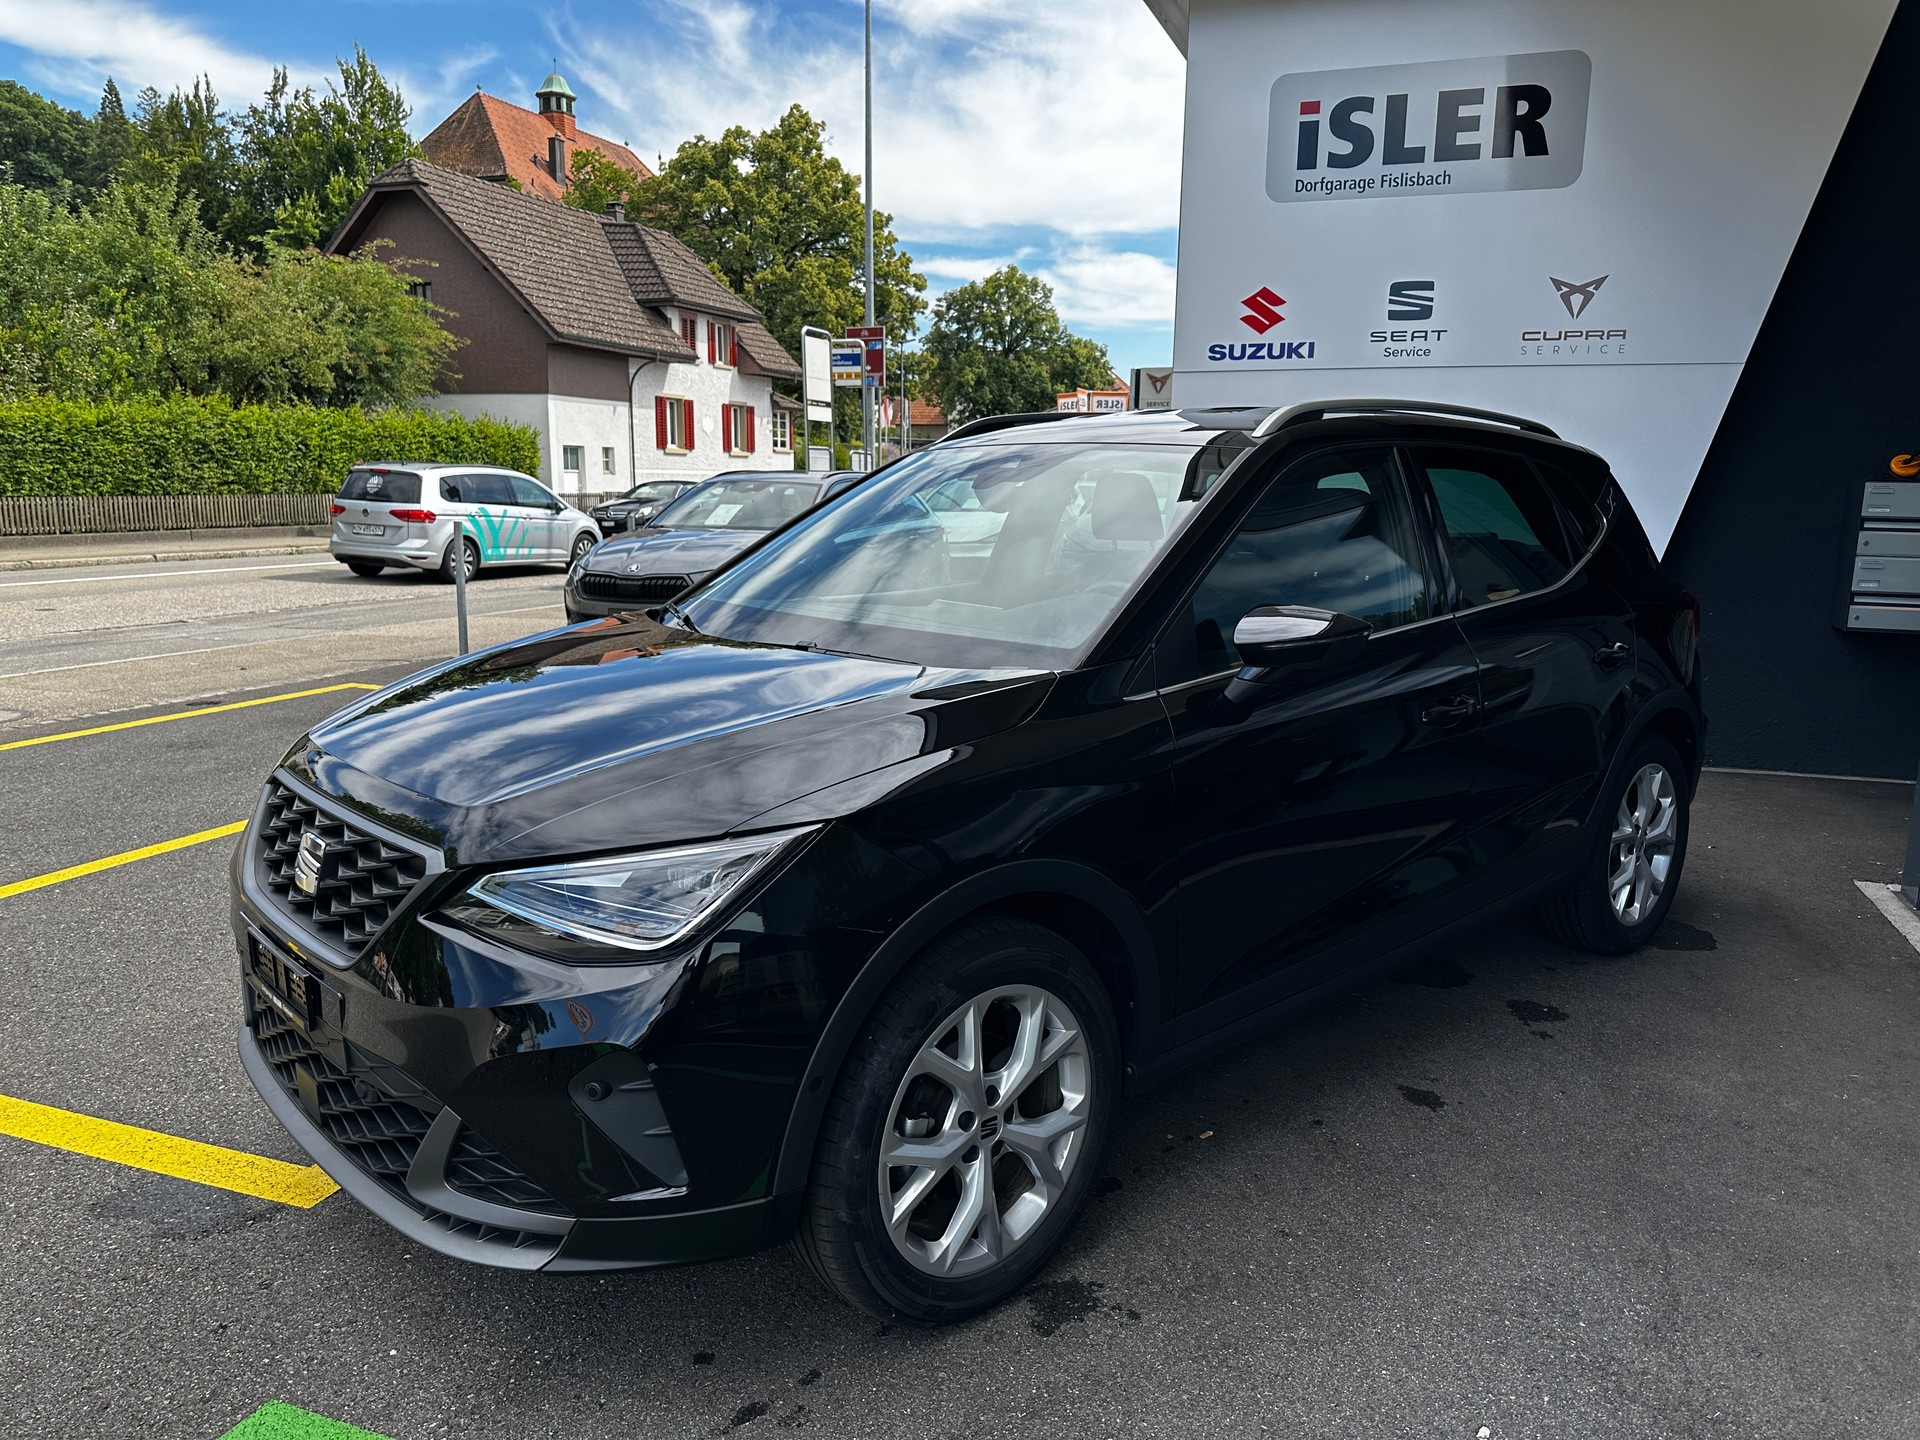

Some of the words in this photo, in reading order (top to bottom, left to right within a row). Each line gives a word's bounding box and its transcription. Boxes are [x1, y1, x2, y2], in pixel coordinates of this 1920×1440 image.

[1297, 84, 1552, 171] iSLER
[1295, 175, 1375, 196] Dorfgarage
[1380, 170, 1451, 189] Fislisbach
[1370, 329, 1448, 343] SEAT
[1521, 329, 1627, 342] CUPRA
[1207, 341, 1316, 362] SUZUKI
[1383, 345, 1431, 358] Service
[1520, 344, 1627, 355] SERVICE
